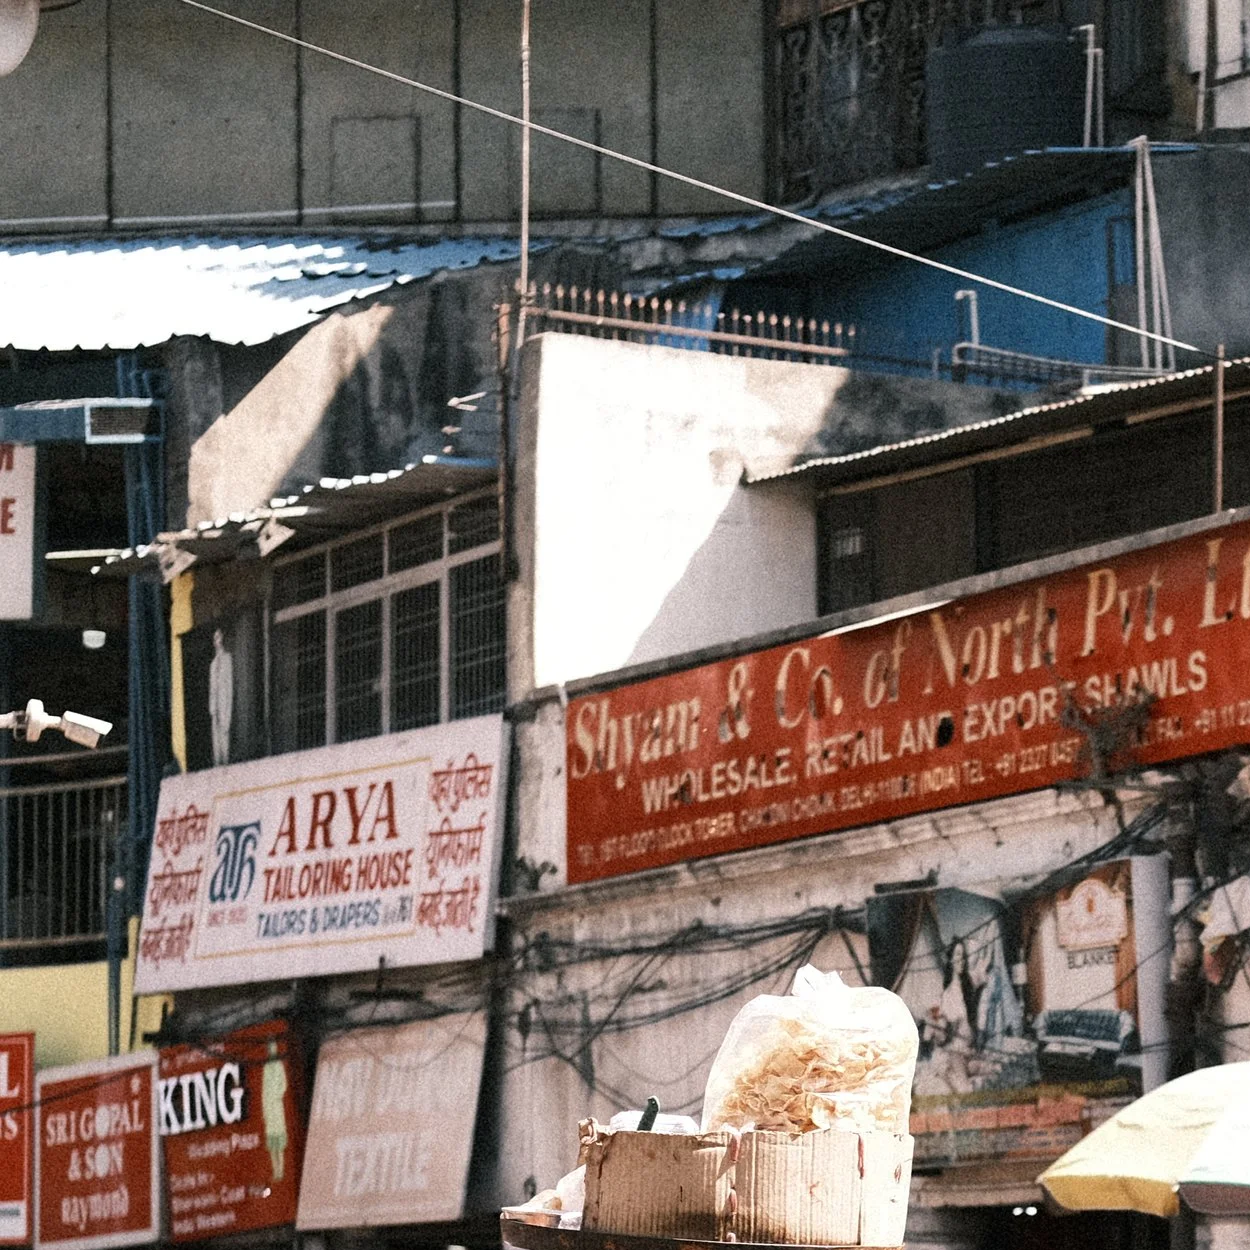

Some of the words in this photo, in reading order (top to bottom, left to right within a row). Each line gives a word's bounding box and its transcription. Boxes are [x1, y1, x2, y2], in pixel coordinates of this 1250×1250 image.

[571, 697, 701, 791] Shyam
[718, 661, 754, 745] &
[776, 646, 844, 729] Co.
[864, 618, 912, 709] of
[921, 583, 1058, 696] North
[1080, 567, 1174, 657] Pvt.
[804, 726, 892, 778] RETAIL
[1084, 649, 1208, 714] SHAWLS
[268, 779, 398, 858] ARYA
[263, 858, 353, 904] TAILORING
[356, 848, 413, 892] HOUSE
[257, 907, 306, 938] TAILORS
[309, 906, 319, 935] &
[322, 897, 382, 931] DRAPERS
[46, 1110, 76, 1147] SRI
[79, 1100, 144, 1142] GOPAL
[158, 1061, 244, 1137] KING
[84, 1141, 125, 1181] SON
